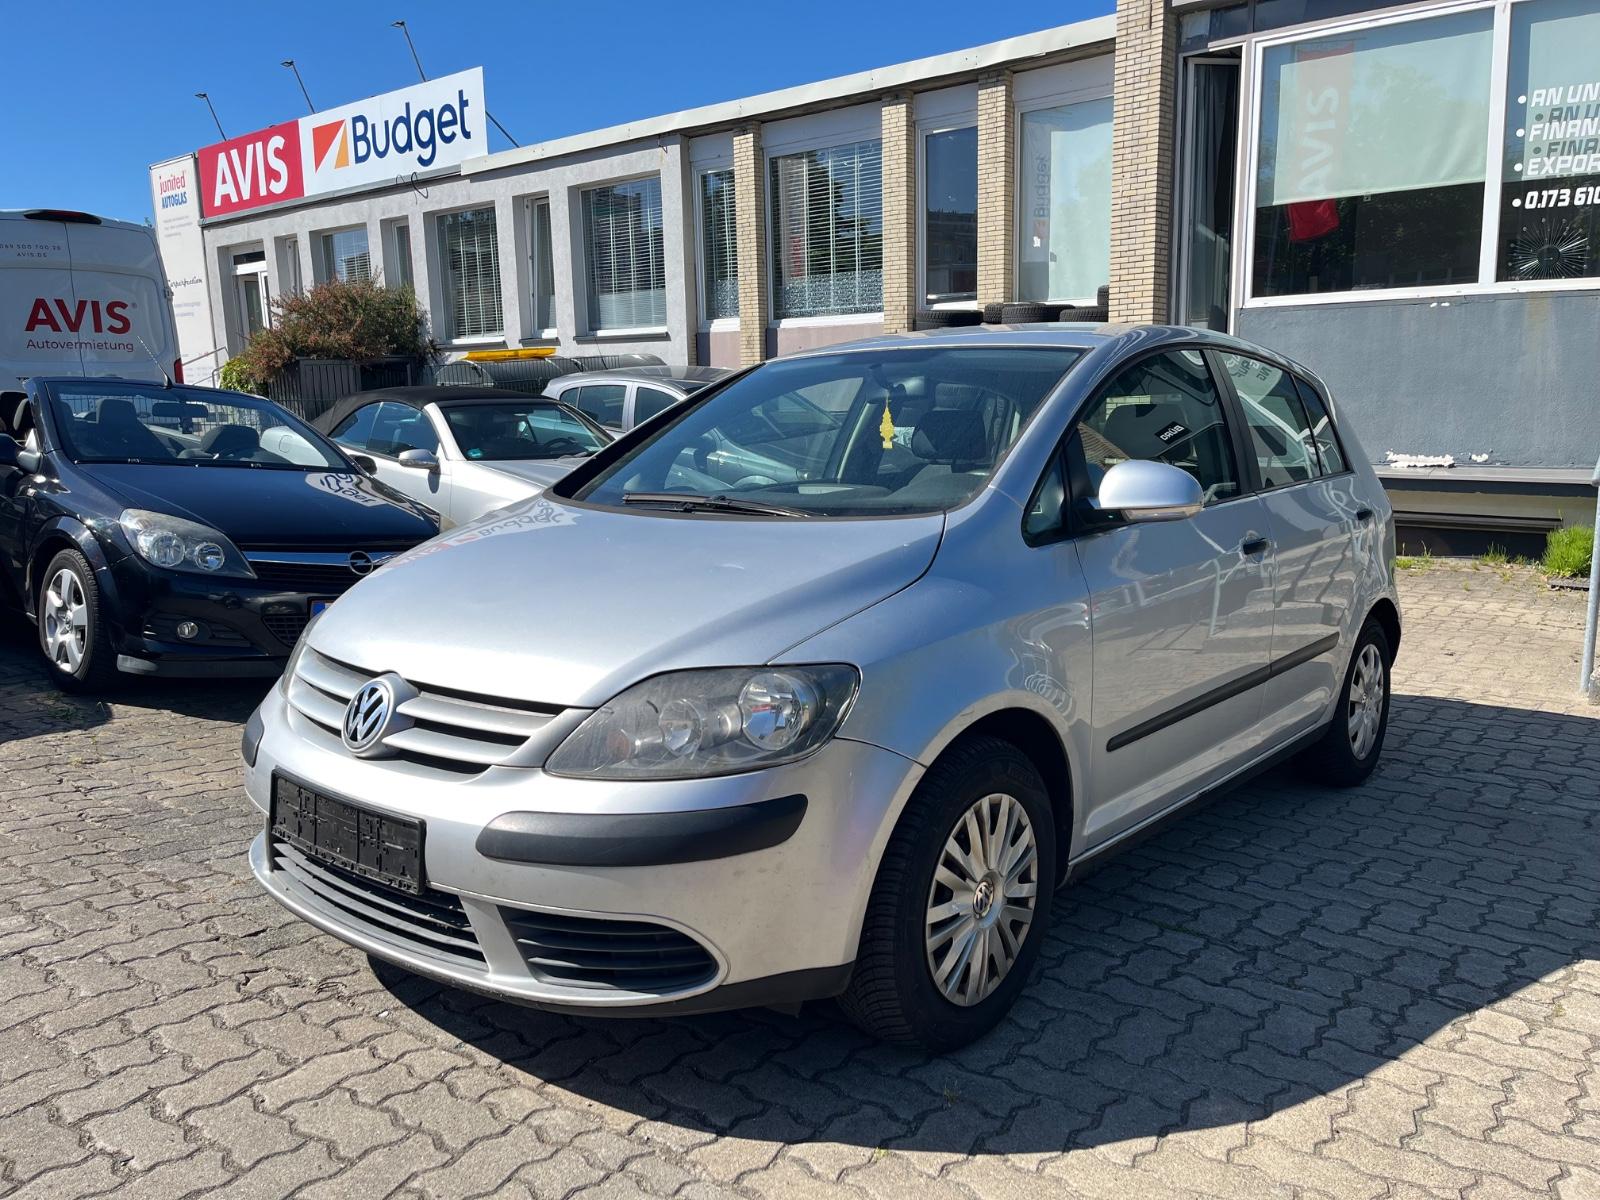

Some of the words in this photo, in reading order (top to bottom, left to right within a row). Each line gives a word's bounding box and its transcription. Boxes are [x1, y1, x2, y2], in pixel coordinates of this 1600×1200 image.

[1530, 87, 1564, 108] AN
[351, 89, 471, 167] Budget
[1528, 117, 1600, 142] FINAN
[159, 170, 186, 195] junited
[213, 135, 288, 207] AVIS
[161, 191, 188, 209] AUTOGLAS
[24, 298, 131, 334] AVIS
[26, 339, 134, 352] Autovermietung
